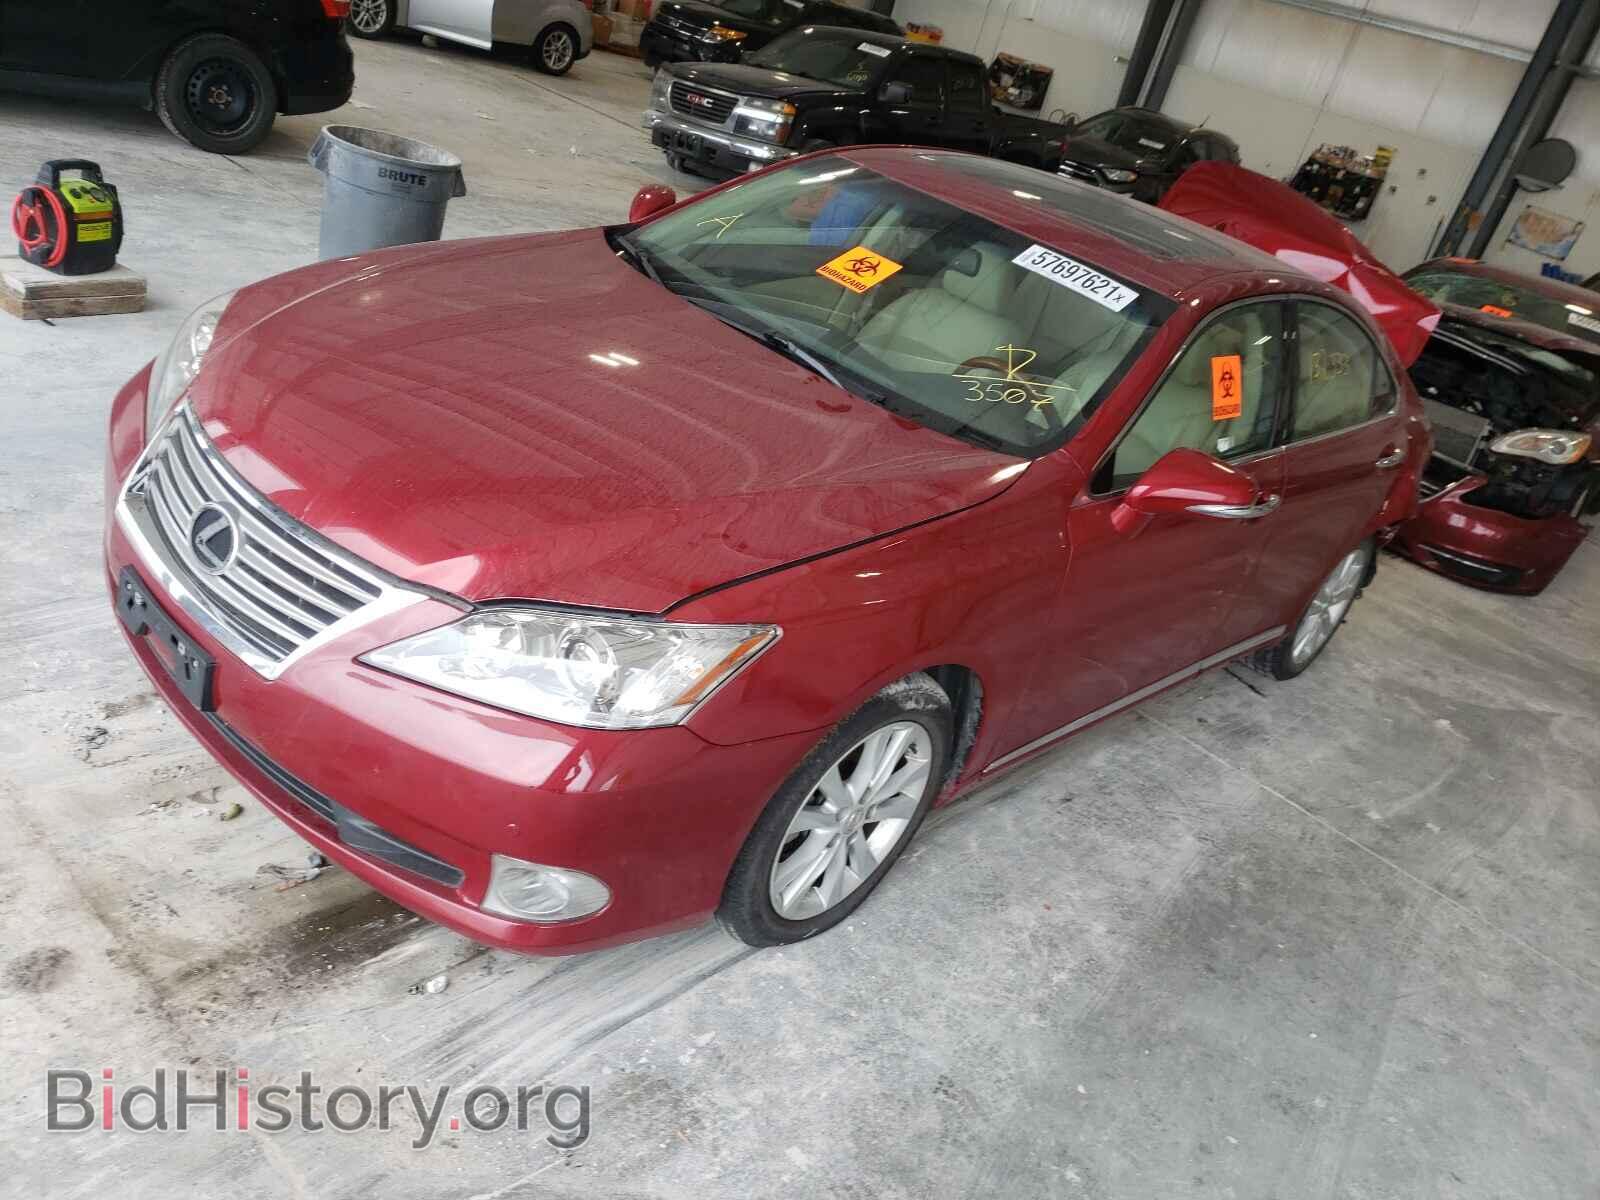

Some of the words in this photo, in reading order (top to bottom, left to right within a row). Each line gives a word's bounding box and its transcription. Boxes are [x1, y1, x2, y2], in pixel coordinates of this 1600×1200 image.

[377, 167, 427, 186] BRUTE
[819, 265, 867, 291] BIOHAZARD
[1031, 250, 1122, 299] 57697621
